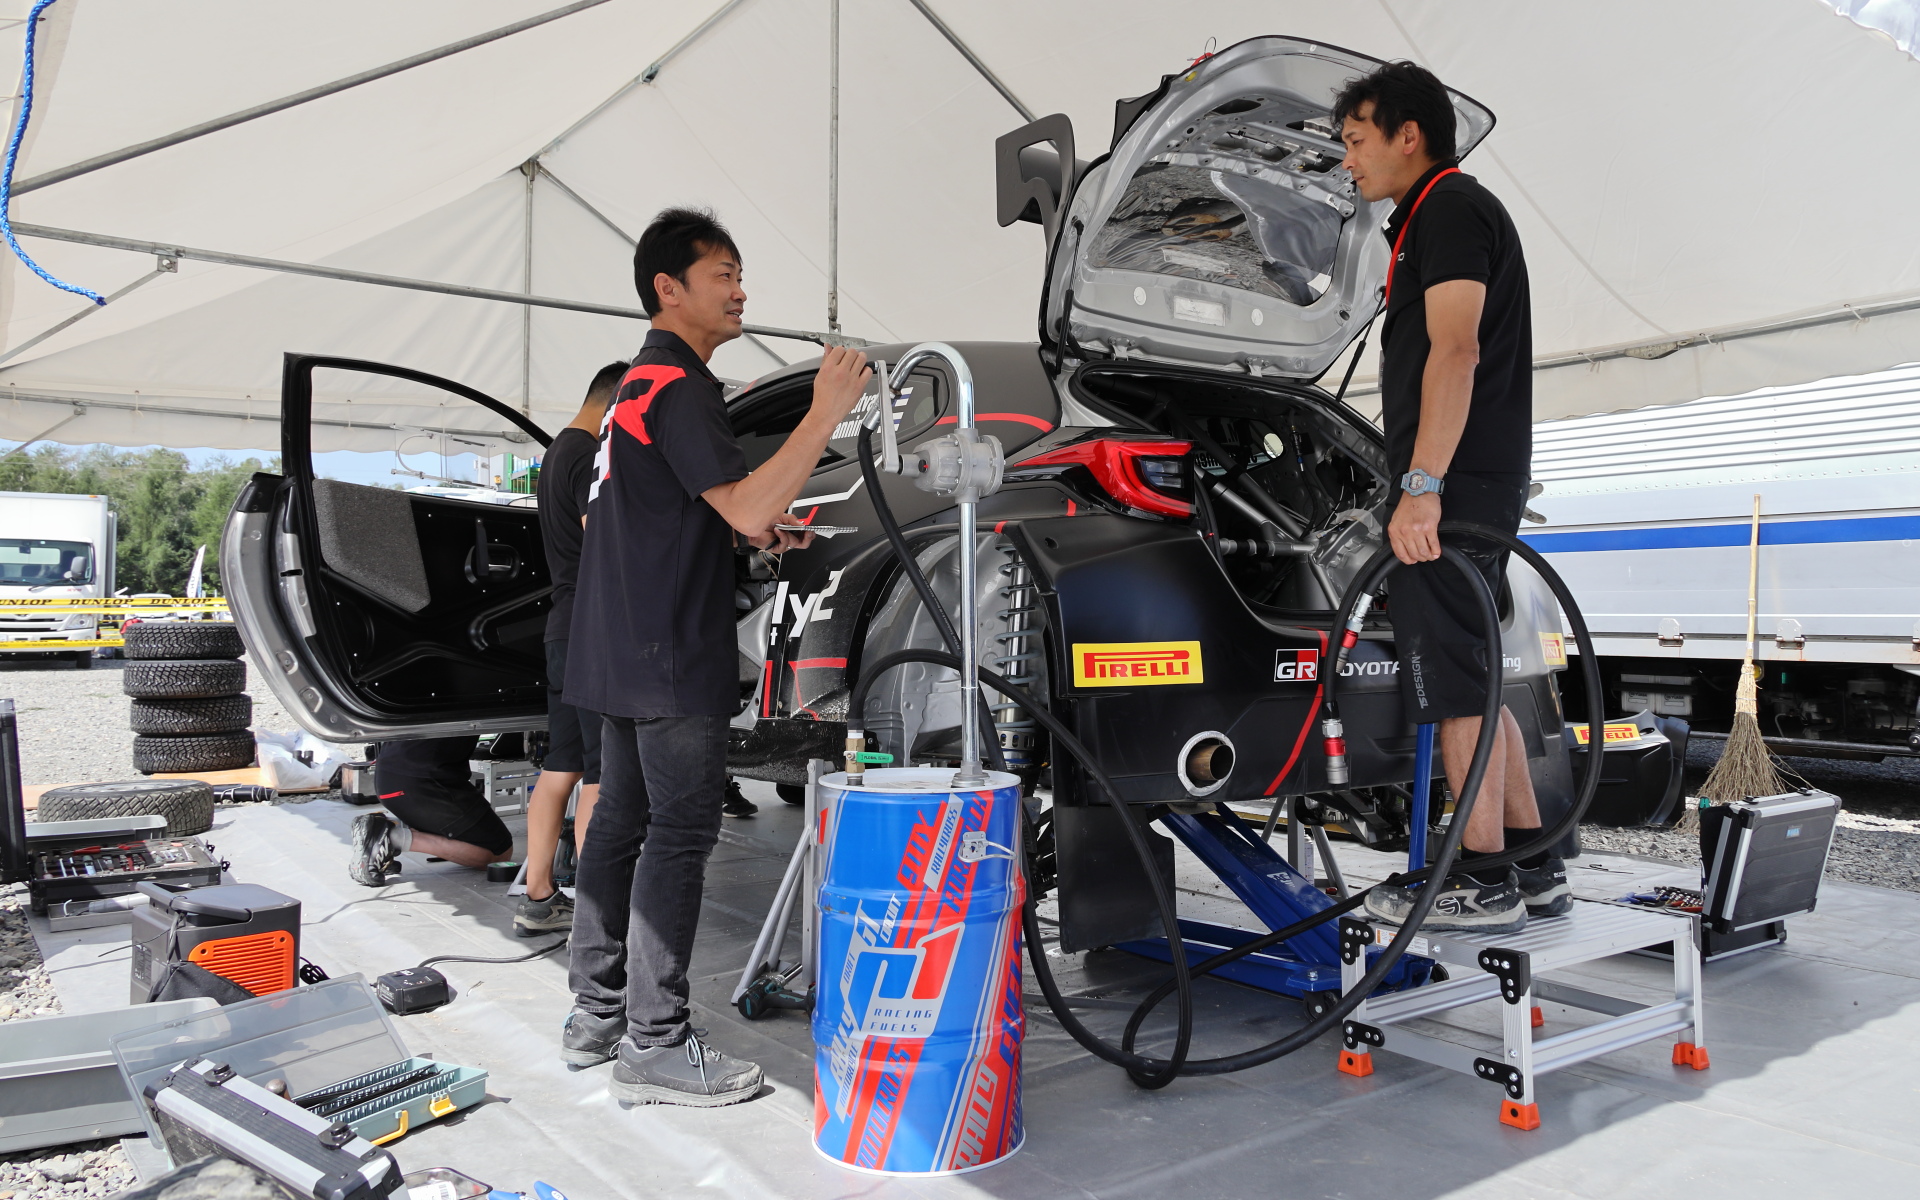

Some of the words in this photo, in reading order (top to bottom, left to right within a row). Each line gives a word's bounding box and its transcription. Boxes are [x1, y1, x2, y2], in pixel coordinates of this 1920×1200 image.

[1083, 649, 1190, 679] PIRELLI
[1276, 661, 1317, 679] GR
[1579, 727, 1634, 740] PELLI
[930, 807, 958, 875] RALLYCROSS
[880, 892, 902, 944] CIRCUIT
[870, 1021, 918, 1033] FUELS
[873, 1008, 933, 1019] RACING
[839, 1040, 859, 1108] MOTORCYCLE
[954, 1062, 999, 1171] RALLY
